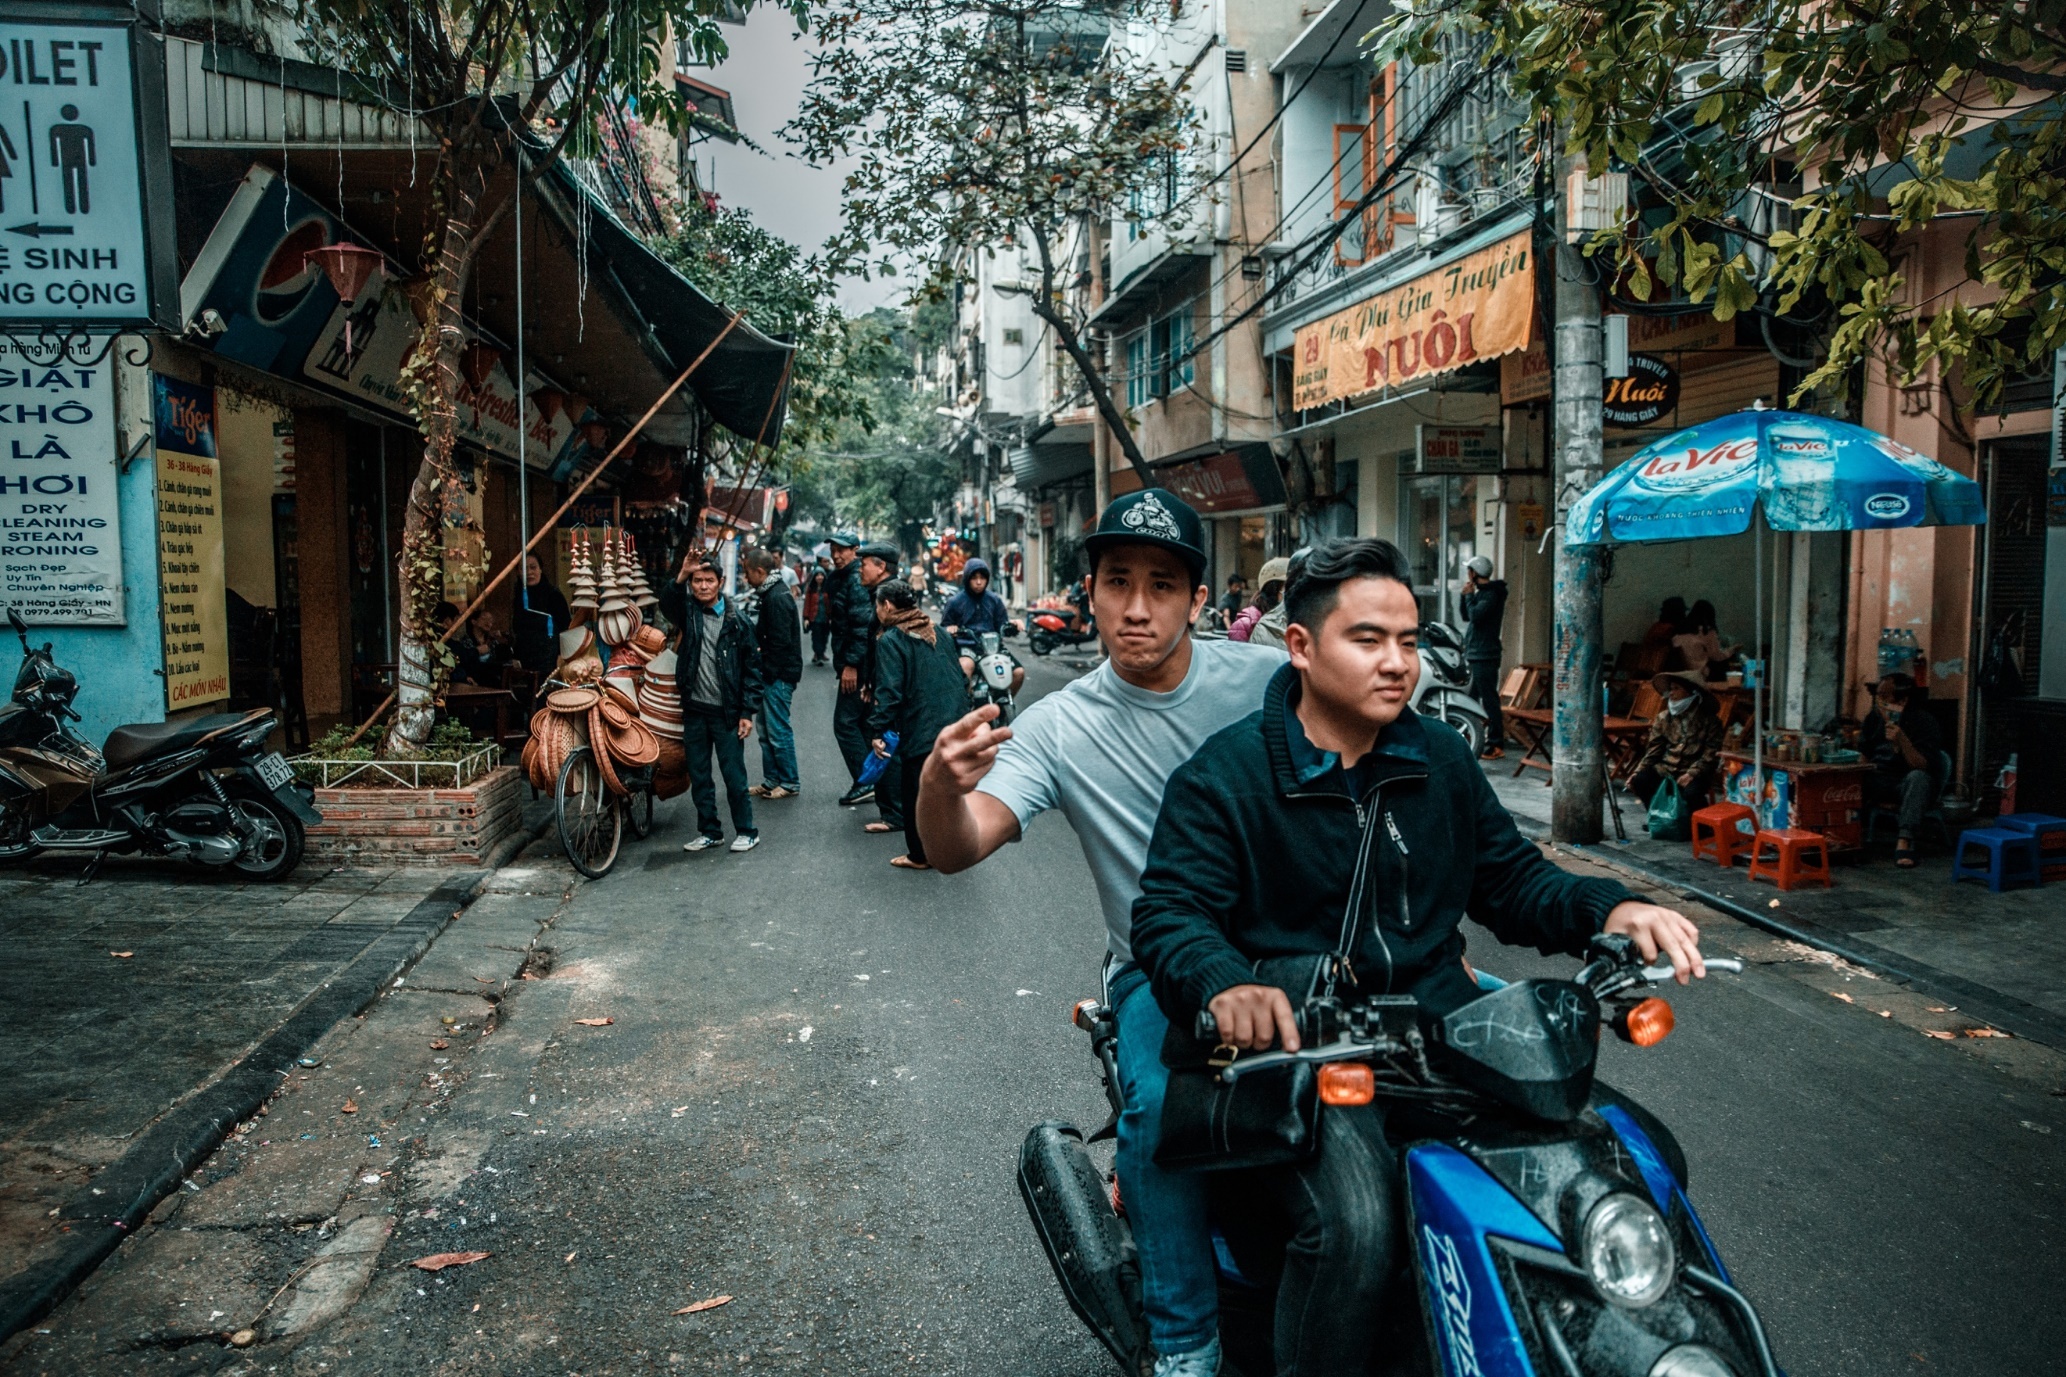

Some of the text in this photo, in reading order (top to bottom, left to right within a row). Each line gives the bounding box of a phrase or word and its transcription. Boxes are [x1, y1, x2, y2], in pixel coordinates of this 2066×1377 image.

[0, 39, 102, 87] ILET
[24, 247, 118, 270] SINH
[45, 280, 136, 309] CỘNG
[1364, 309, 1477, 387] NUÔI
[1604, 377, 1668, 404] Nuôi
[168, 395, 211, 445] Tiger
[11, 433, 72, 459] LÀ
[22, 504, 68, 514] DRY
[0, 518, 107, 529] LEANING
[8, 532, 83, 542] STEAM
[5, 564, 37, 573] Sạch
[7, 574, 22, 583] Uy
[7, 584, 104, 593] Chuyên Nghiệp
[27, 599, 56, 608] Hàng
[173, 675, 227, 701] CÁC MÓN NHẬU
[266, 765, 292, 788] 378.72
